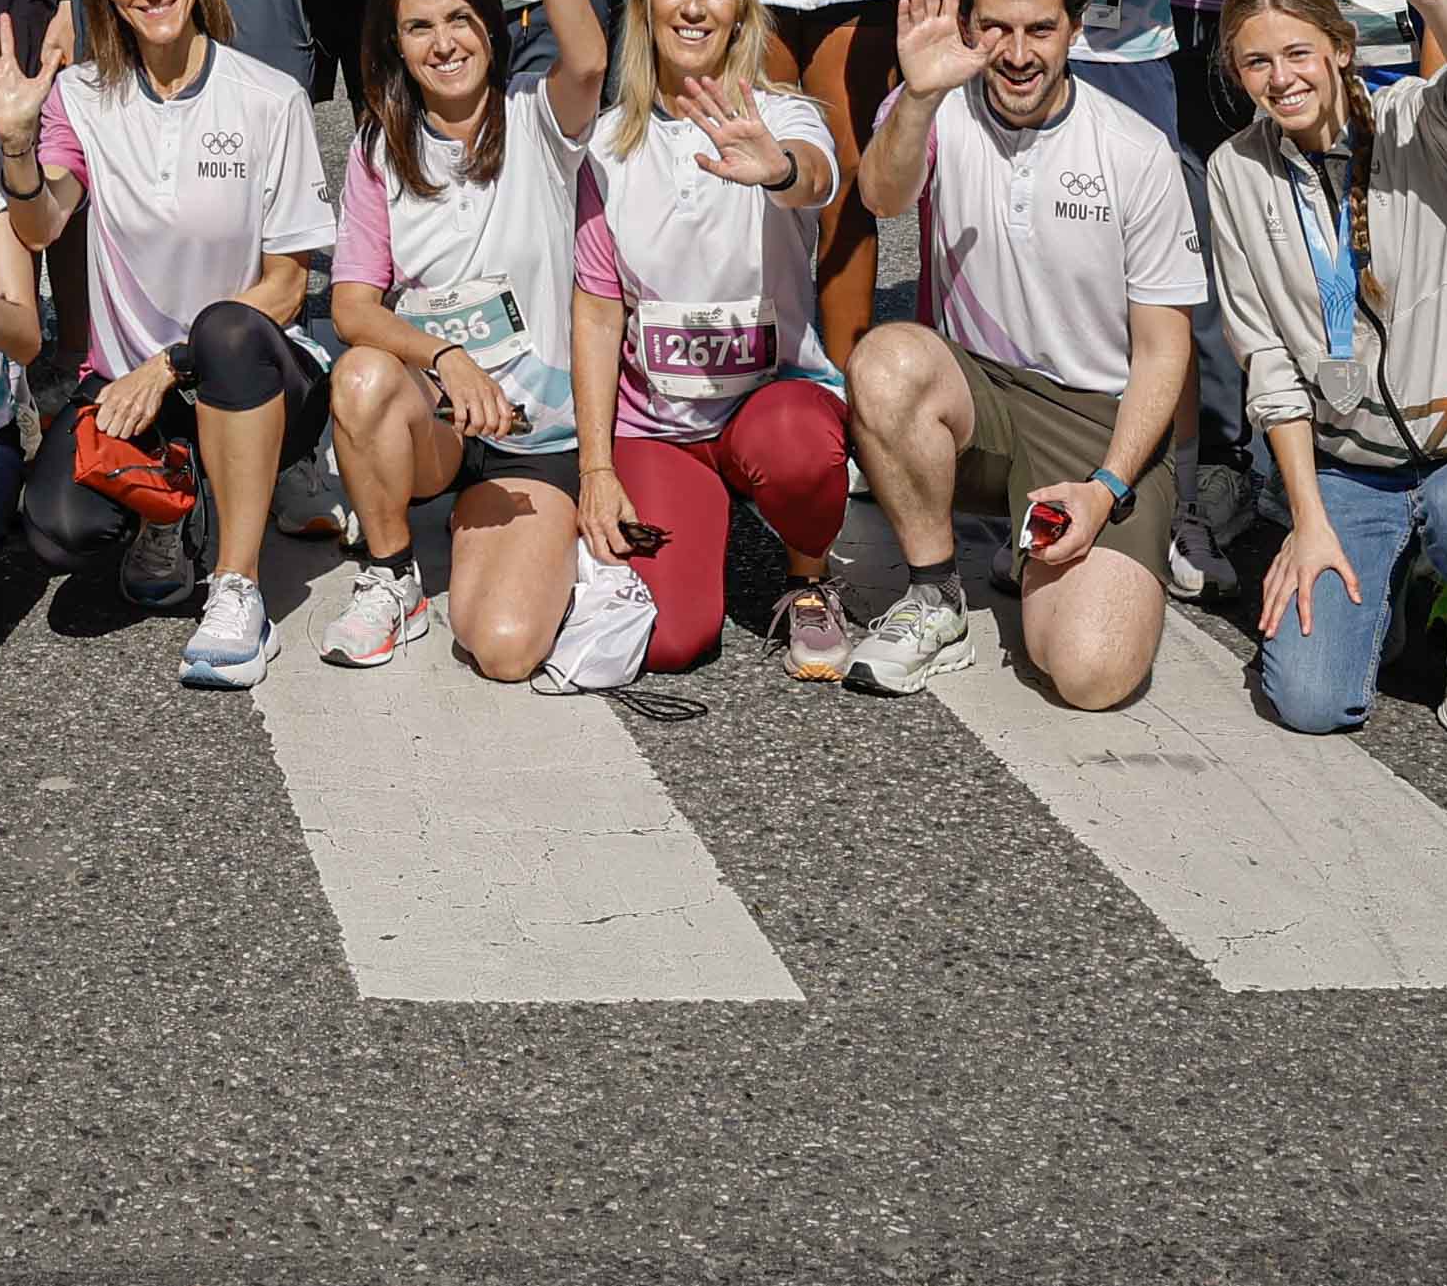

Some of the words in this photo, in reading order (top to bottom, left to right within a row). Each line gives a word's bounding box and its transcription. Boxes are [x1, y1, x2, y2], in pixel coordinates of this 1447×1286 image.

[198, 161, 246, 179] MOU-TE
[1055, 200, 1110, 223] MOU-TE
[665, 334, 756, 367] 2671
